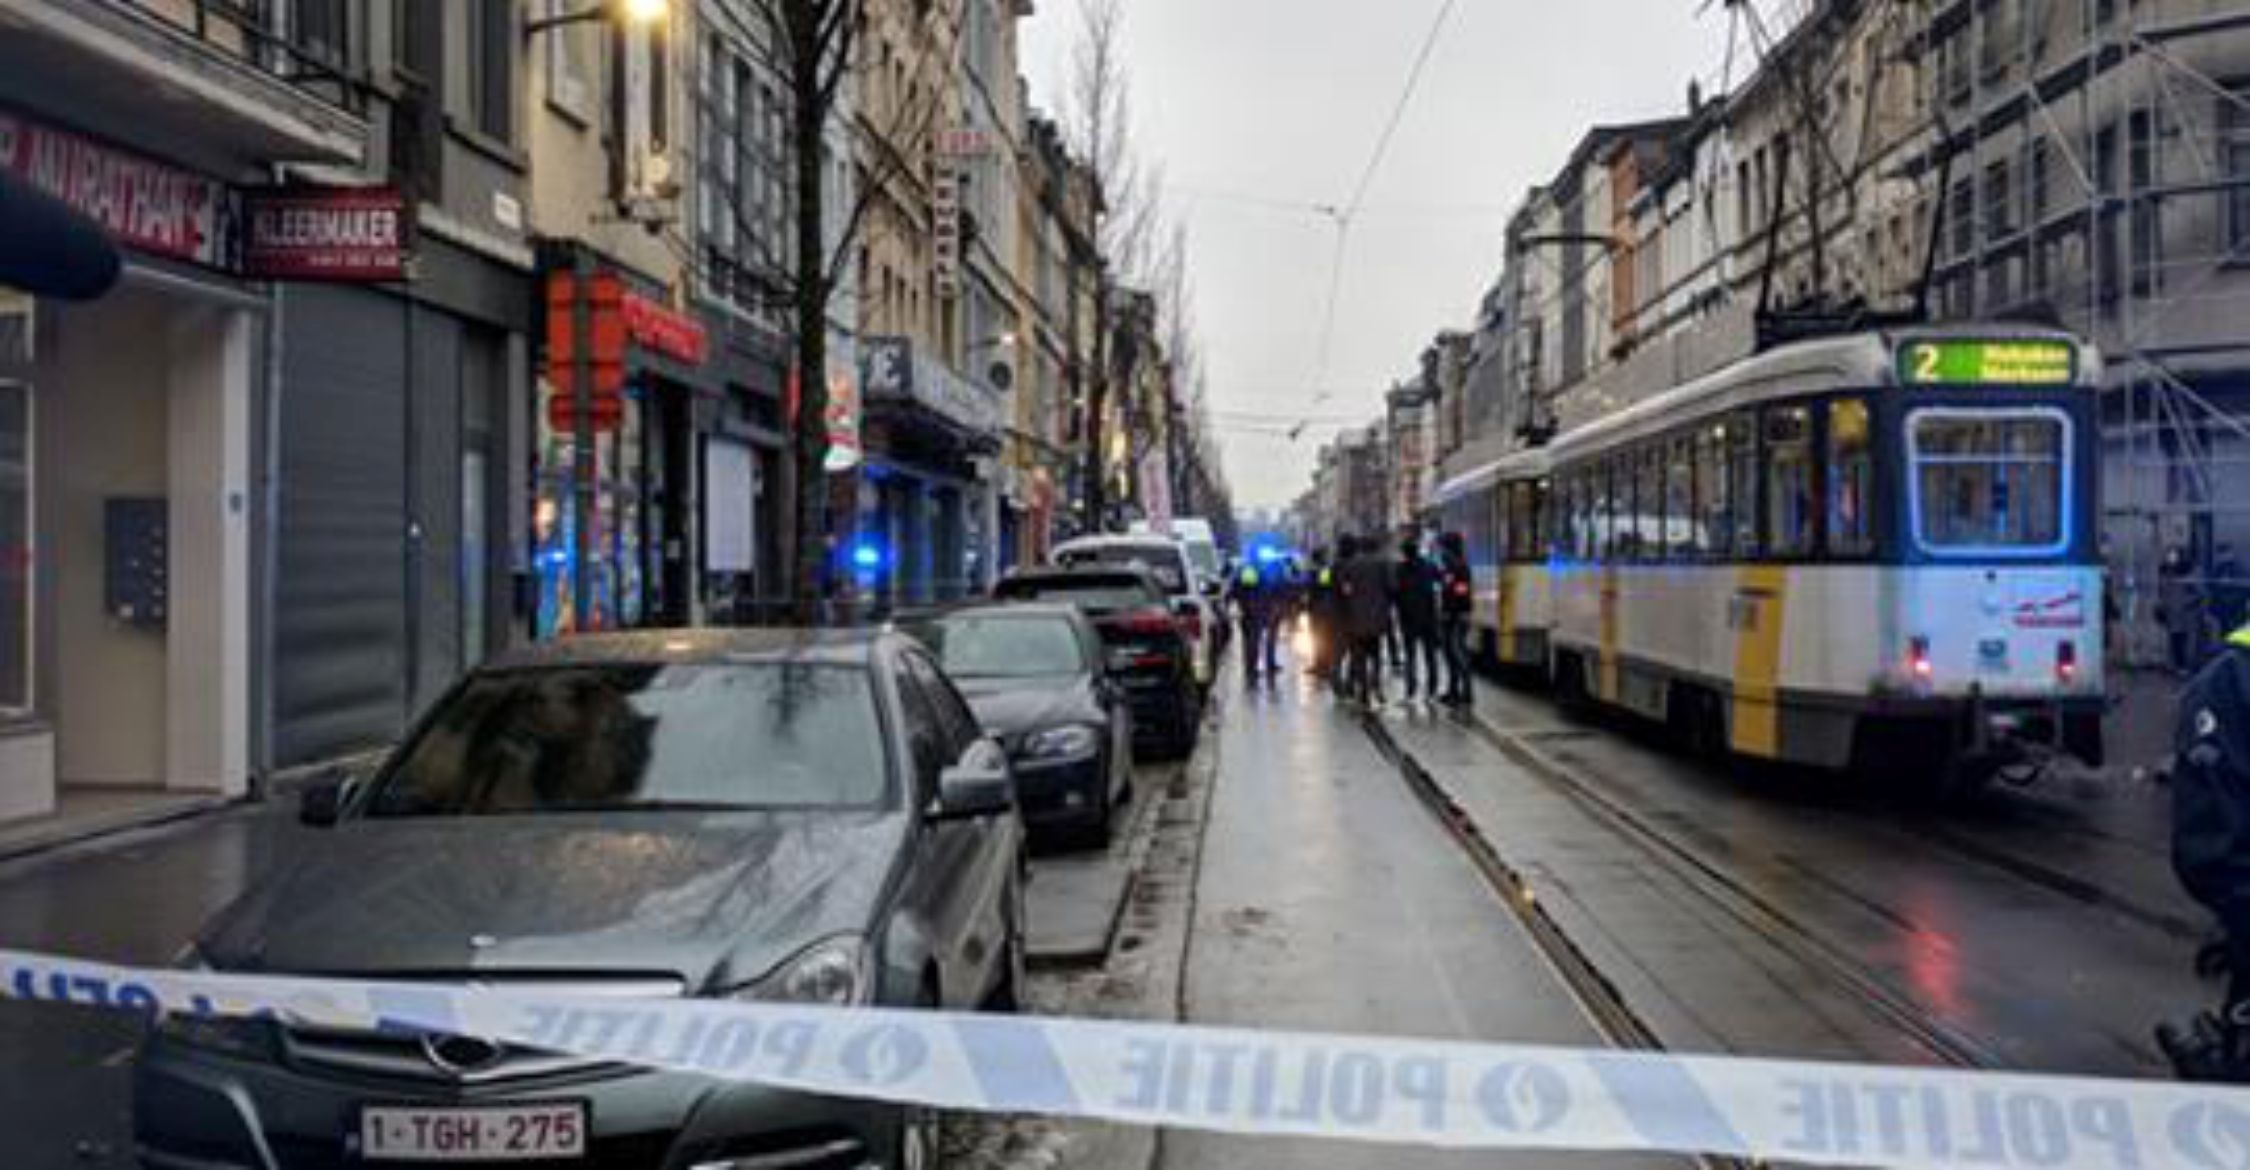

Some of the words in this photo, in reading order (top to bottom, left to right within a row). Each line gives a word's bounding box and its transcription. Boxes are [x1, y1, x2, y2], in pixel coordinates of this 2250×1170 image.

[256, 208, 398, 247] KLEERMAKER
[1913, 344, 1940, 384] 2
[371, 1113, 577, 1151] 1-TGH-275
